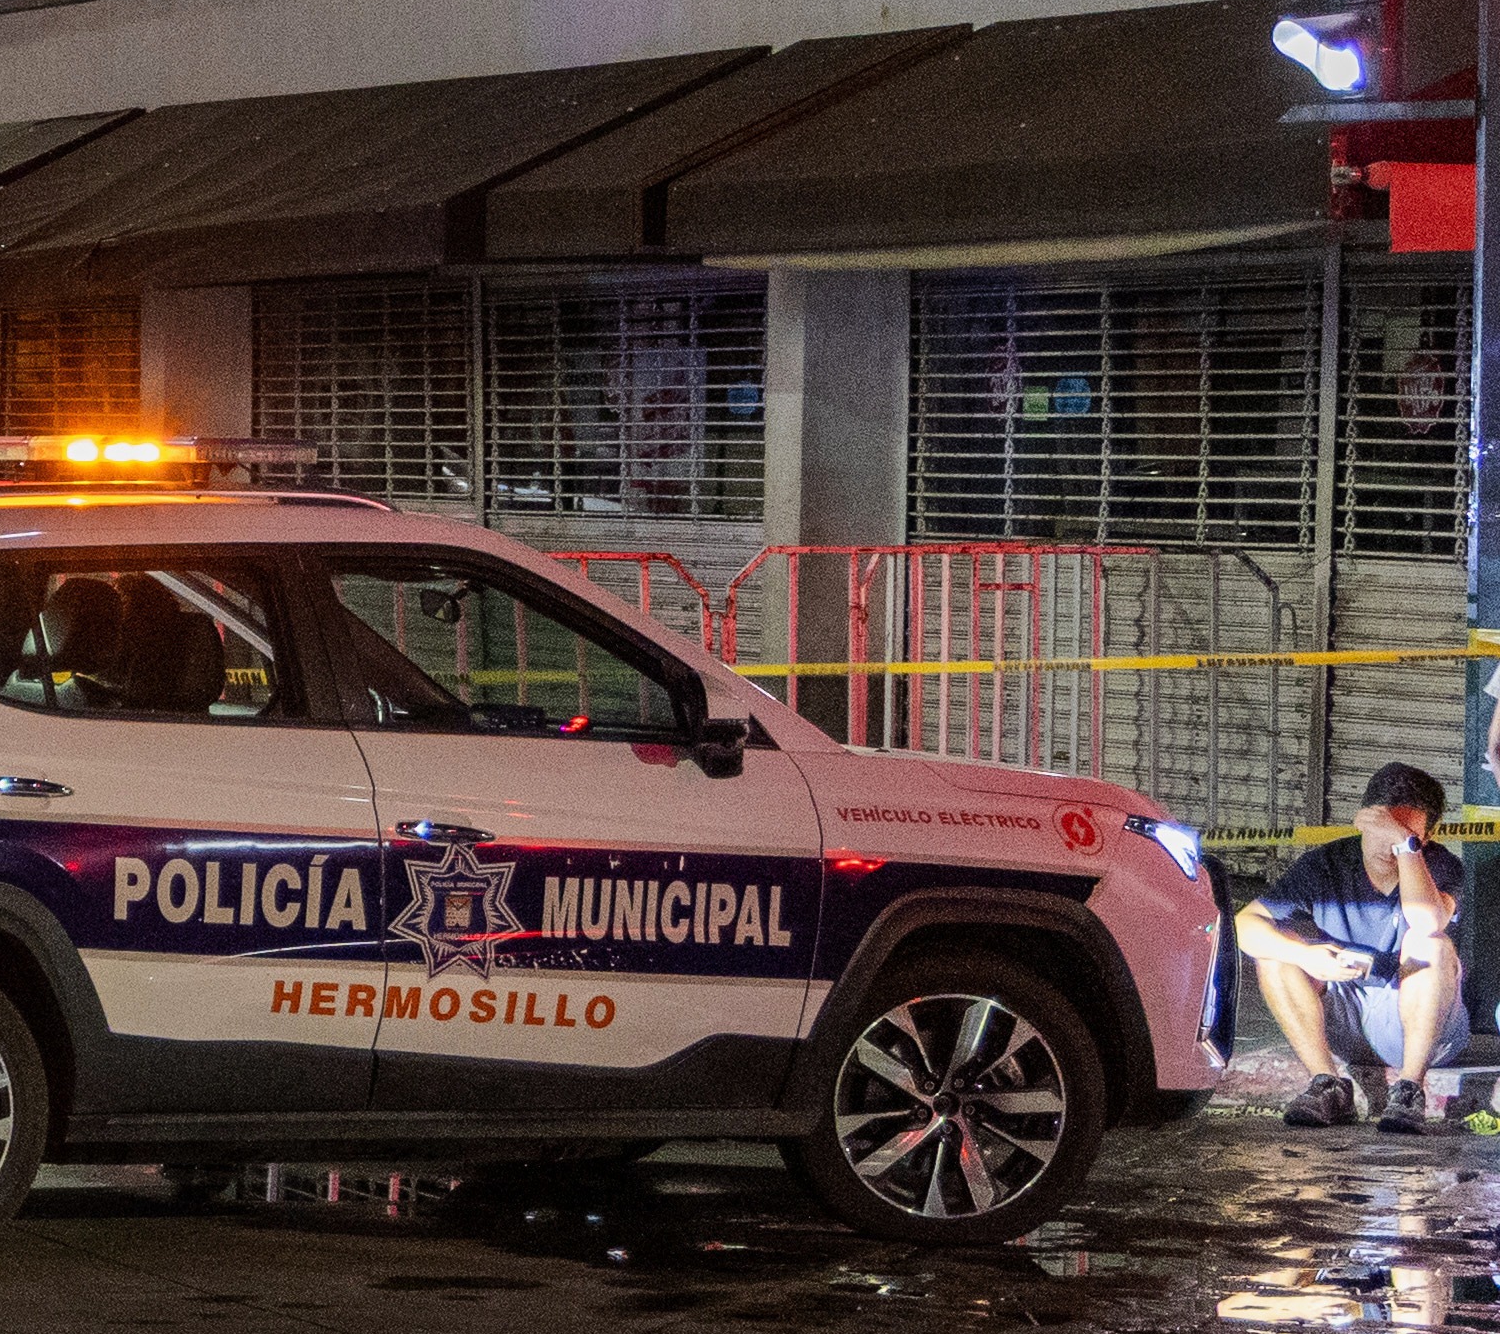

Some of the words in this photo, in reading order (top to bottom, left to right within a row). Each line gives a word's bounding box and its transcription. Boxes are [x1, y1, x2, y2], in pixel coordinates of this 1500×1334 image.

[836, 806, 932, 824] VEHÍCULO
[938, 810, 1041, 830] ELÉCTRICO
[113, 854, 368, 931] POLICÍA
[542, 876, 792, 948] MUNICIPAL
[271, 980, 617, 1030] HERMOSILLO
